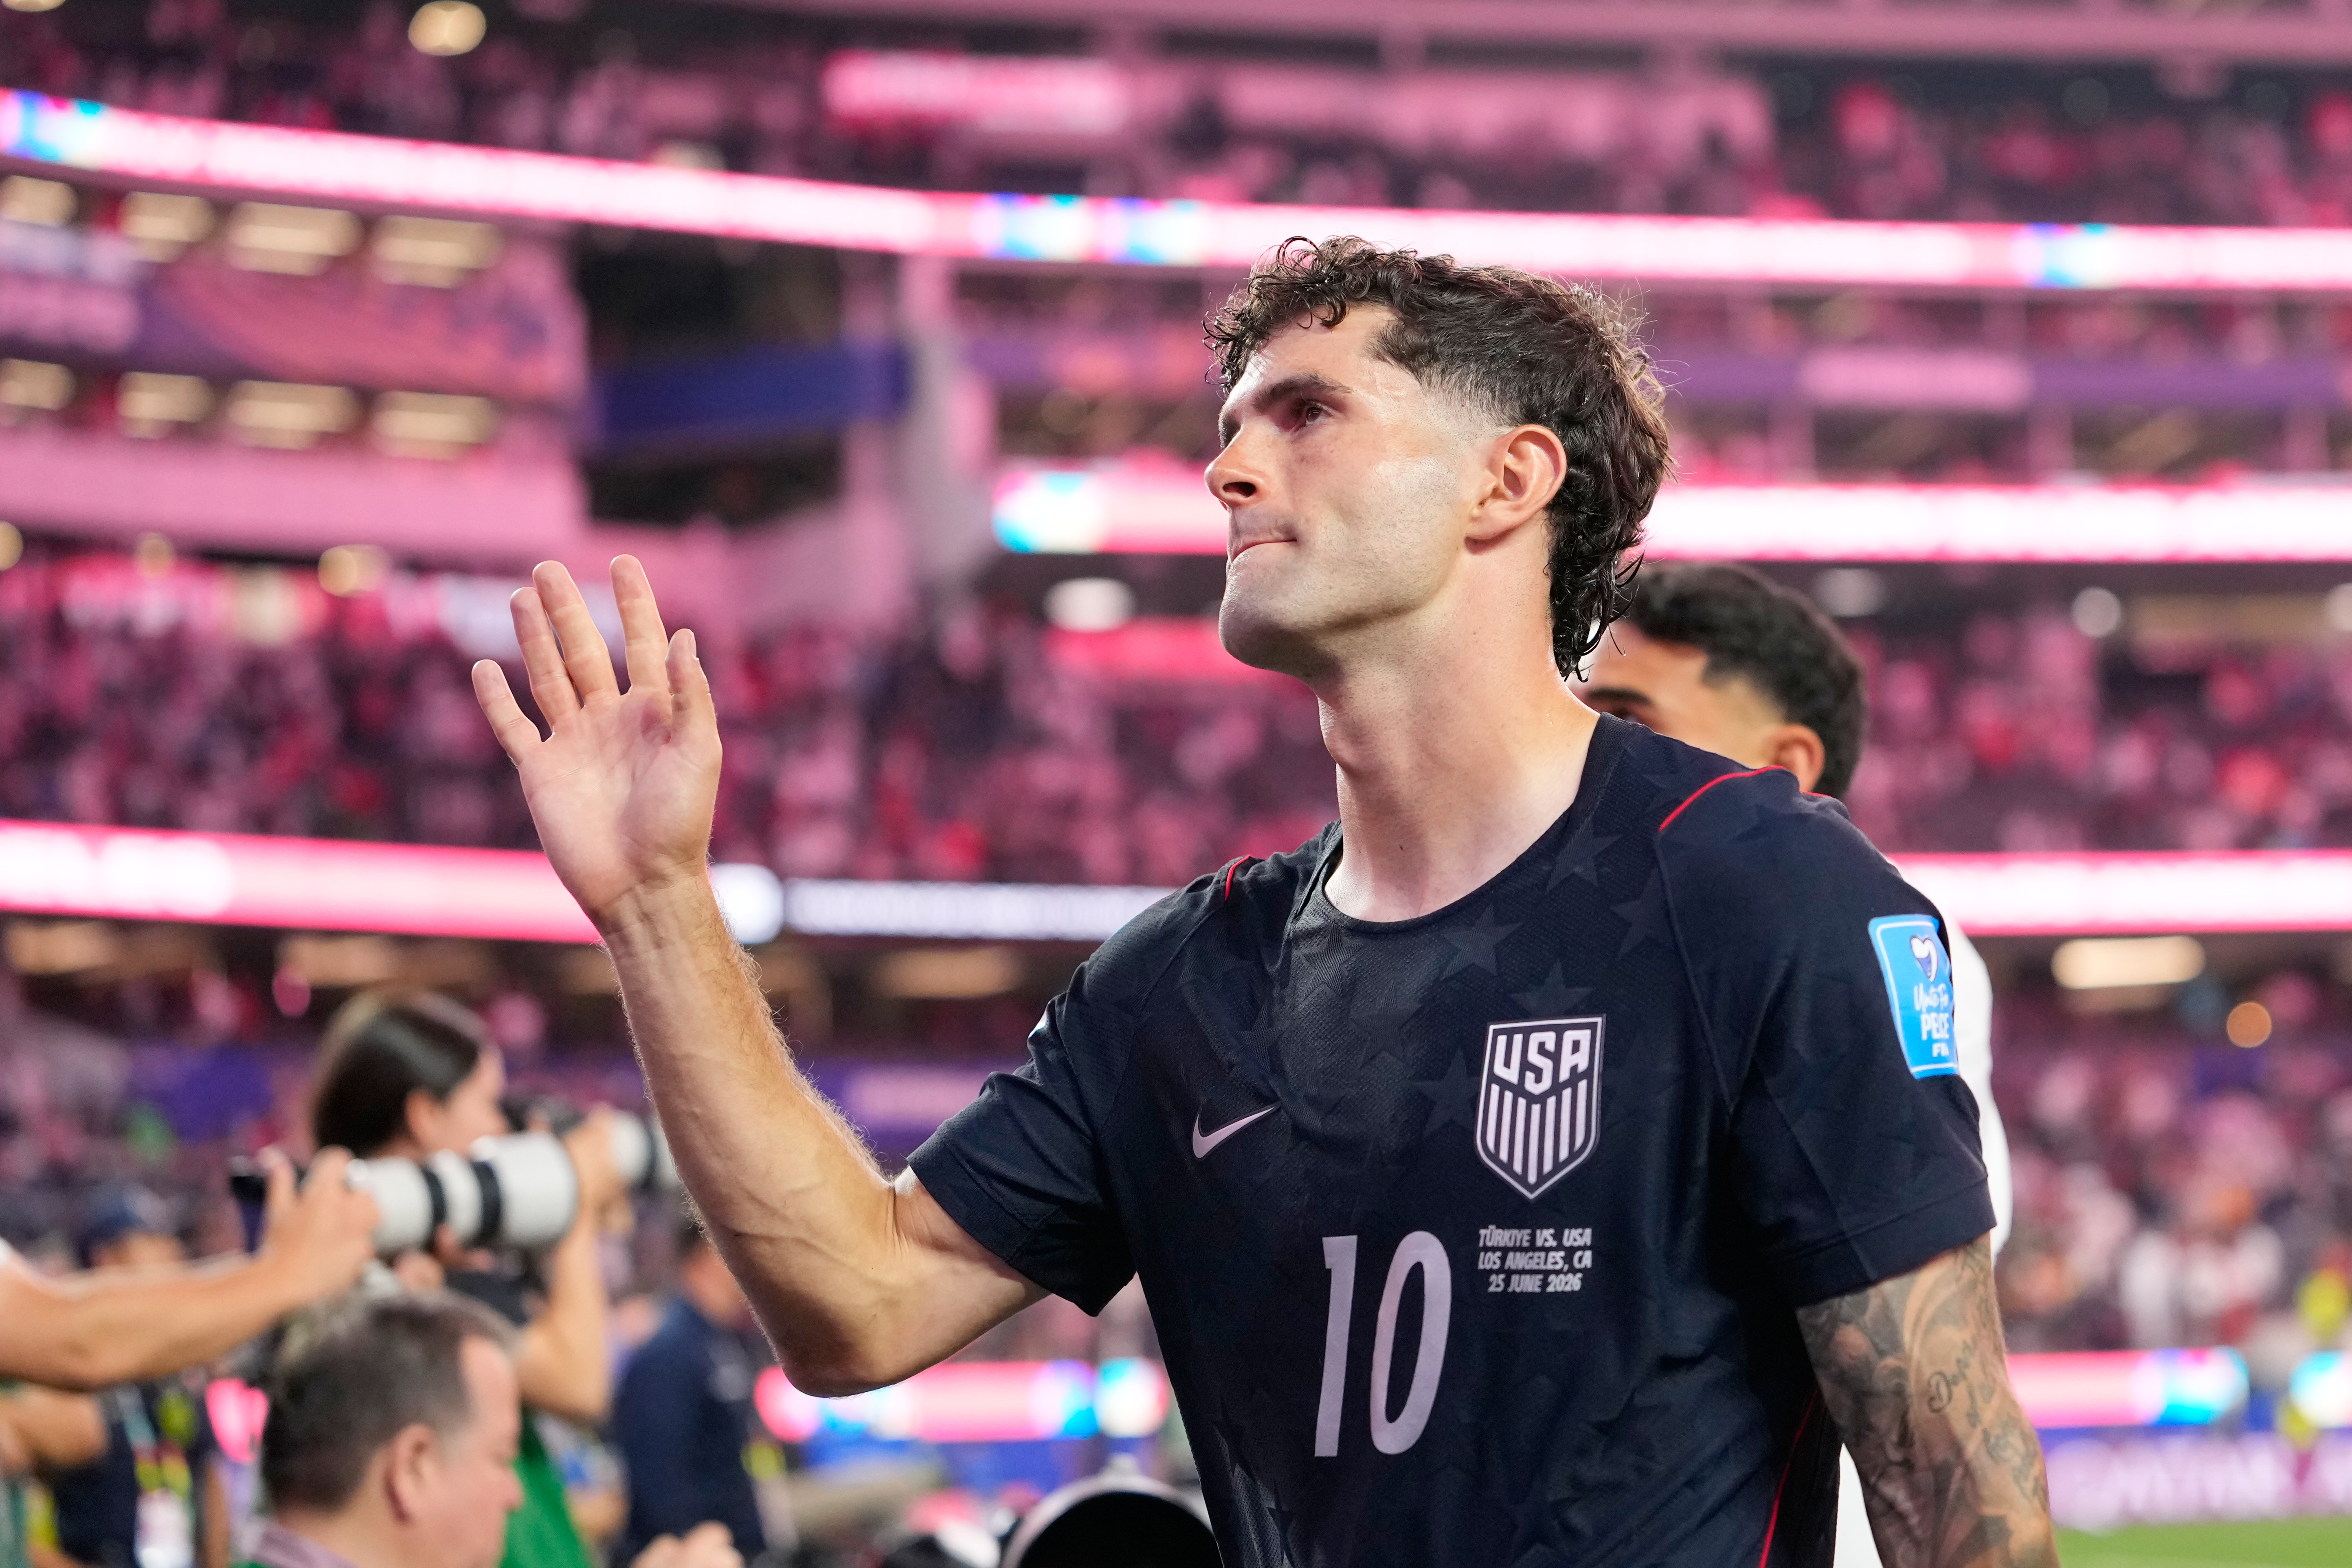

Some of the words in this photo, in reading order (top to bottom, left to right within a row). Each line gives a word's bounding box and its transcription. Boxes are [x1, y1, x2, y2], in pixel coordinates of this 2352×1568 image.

[1493, 1029, 1591, 1095] USA
[1535, 1228, 1557, 1247] VS.
[1562, 1228, 1592, 1247] USA
[1478, 1251, 1502, 1270] LOS
[1504, 1250, 1569, 1273] ANGELES,
[1573, 1250, 1592, 1269] CA
[1487, 1274, 1506, 1293] 25
[1507, 1274, 1544, 1293] JUNE
[1546, 1272, 1583, 1292] 2026
[1314, 1230, 1452, 1457] 10
